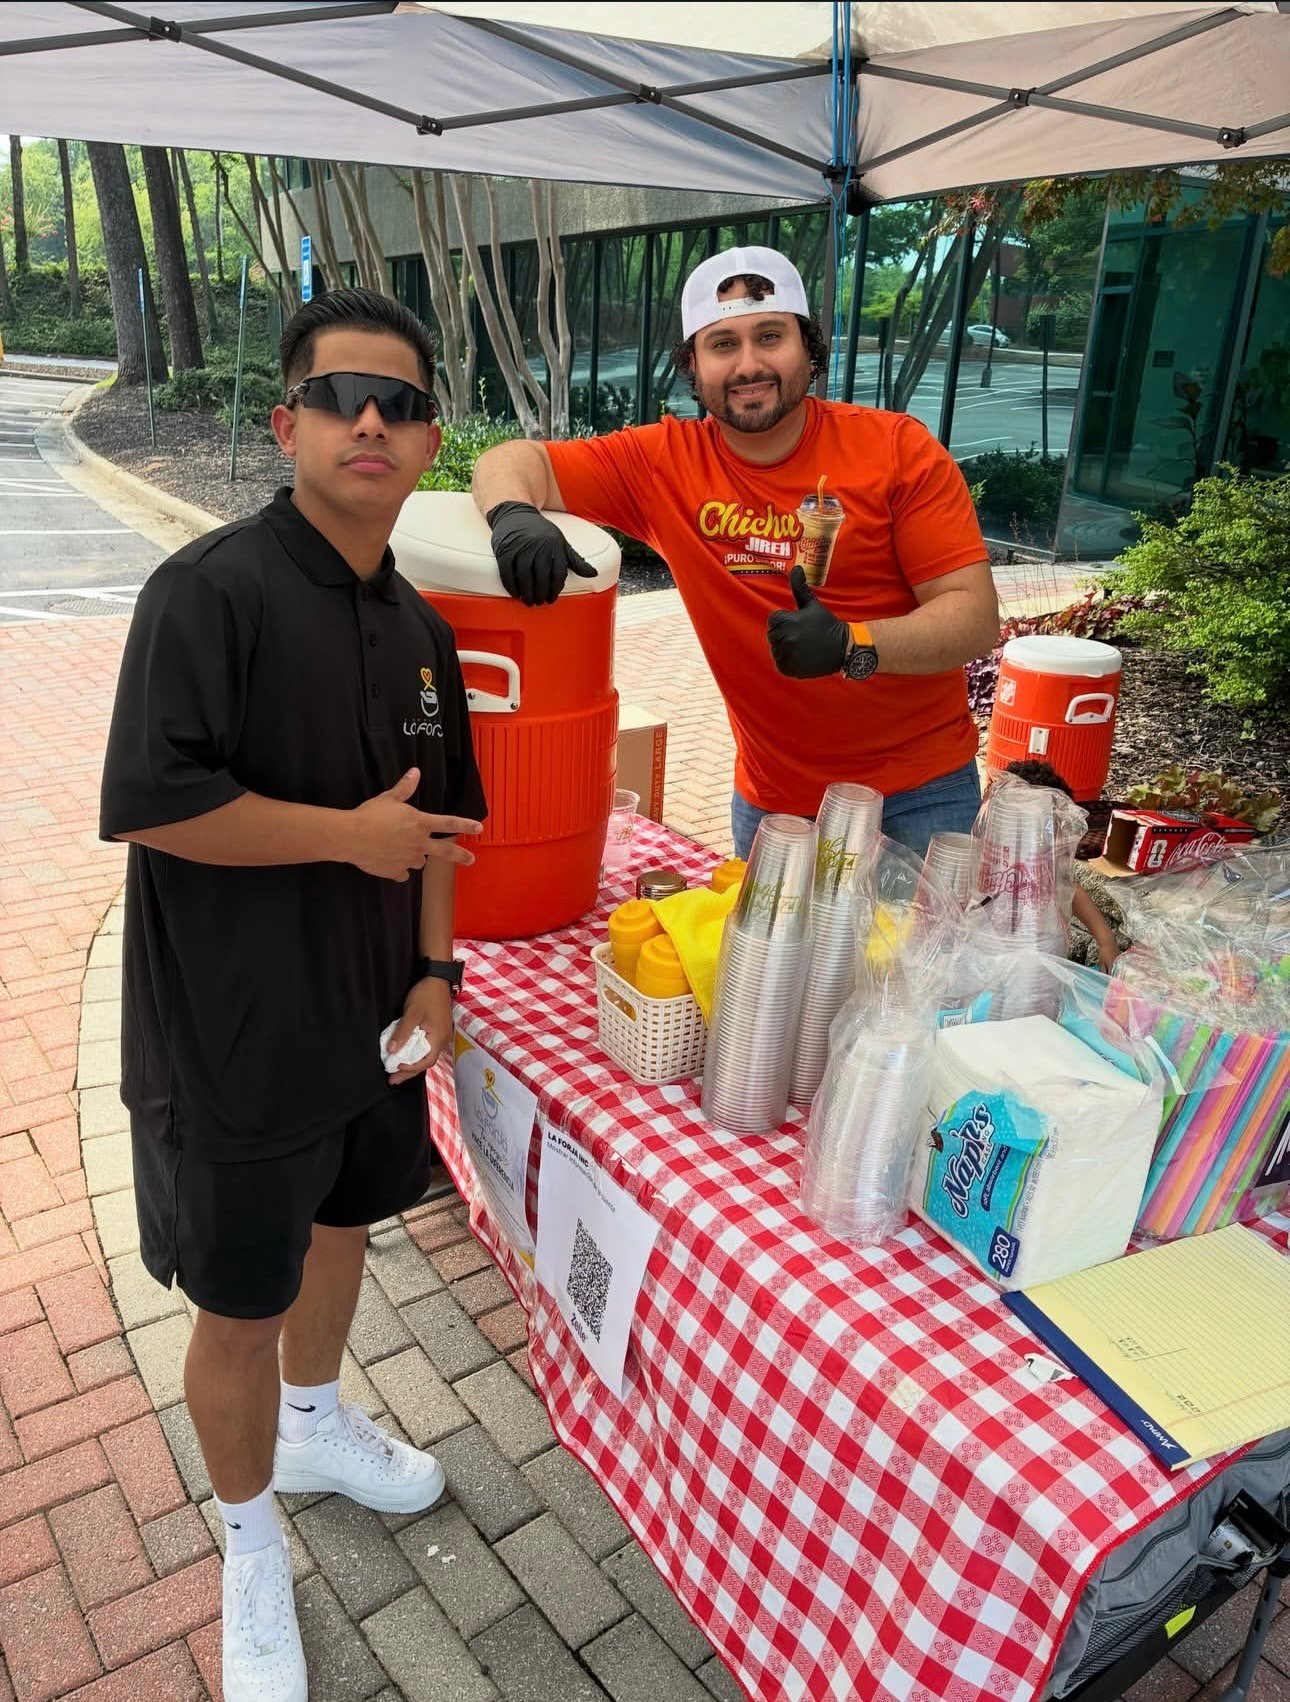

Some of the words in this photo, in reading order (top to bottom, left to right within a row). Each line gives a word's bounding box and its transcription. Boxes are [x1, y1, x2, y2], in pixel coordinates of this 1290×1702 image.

[700, 501, 799, 539] Chicha
[745, 537, 791, 556] JIREH
[547, 1132, 557, 1142] LA
[557, 1137, 578, 1157] FORJA
[990, 1233, 1011, 1269] 280
